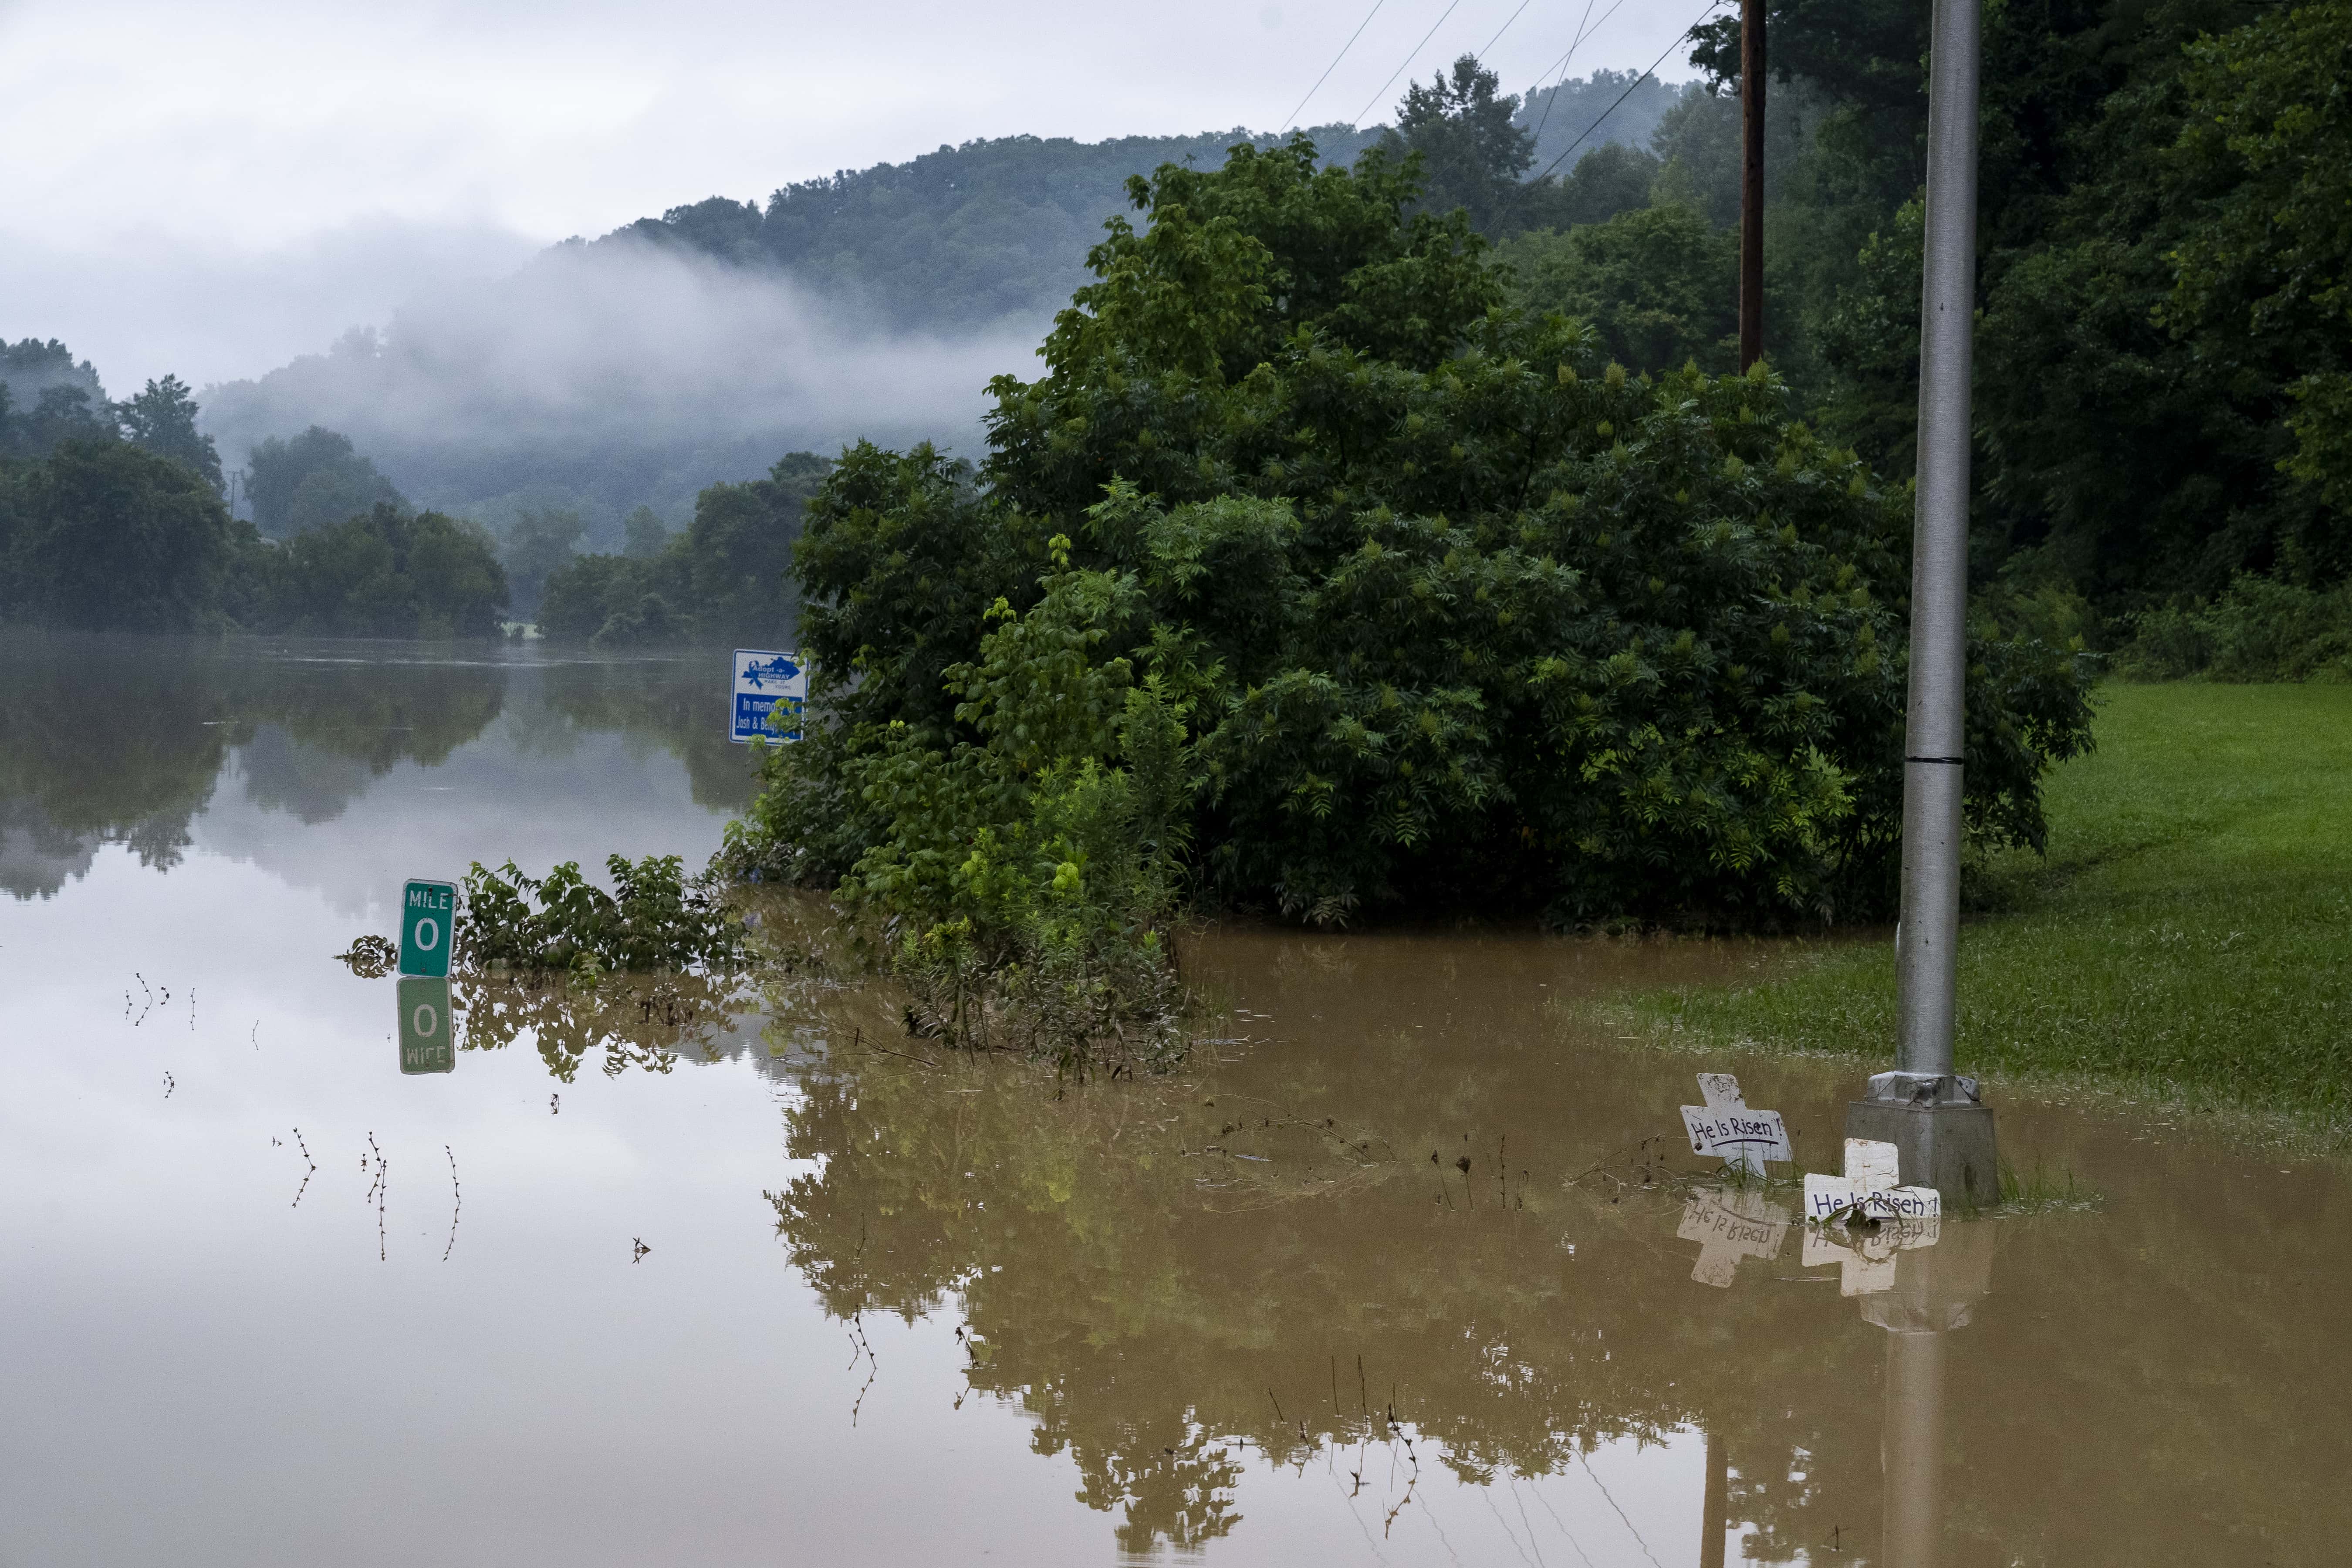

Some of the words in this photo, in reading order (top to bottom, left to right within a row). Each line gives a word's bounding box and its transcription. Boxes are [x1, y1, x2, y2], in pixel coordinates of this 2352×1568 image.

[743, 697, 750, 711] In
[752, 716, 758, 730] &
[409, 890, 449, 909] MILE
[415, 918, 439, 951] 0
[1691, 1122, 1716, 1141] He
[1715, 1119, 1729, 1136] Is
[1730, 1118, 1773, 1136] Risen
[1814, 1194, 1843, 1215] He
[1851, 1192, 1865, 1209] Is
[1872, 1192, 1924, 1216] Risen
